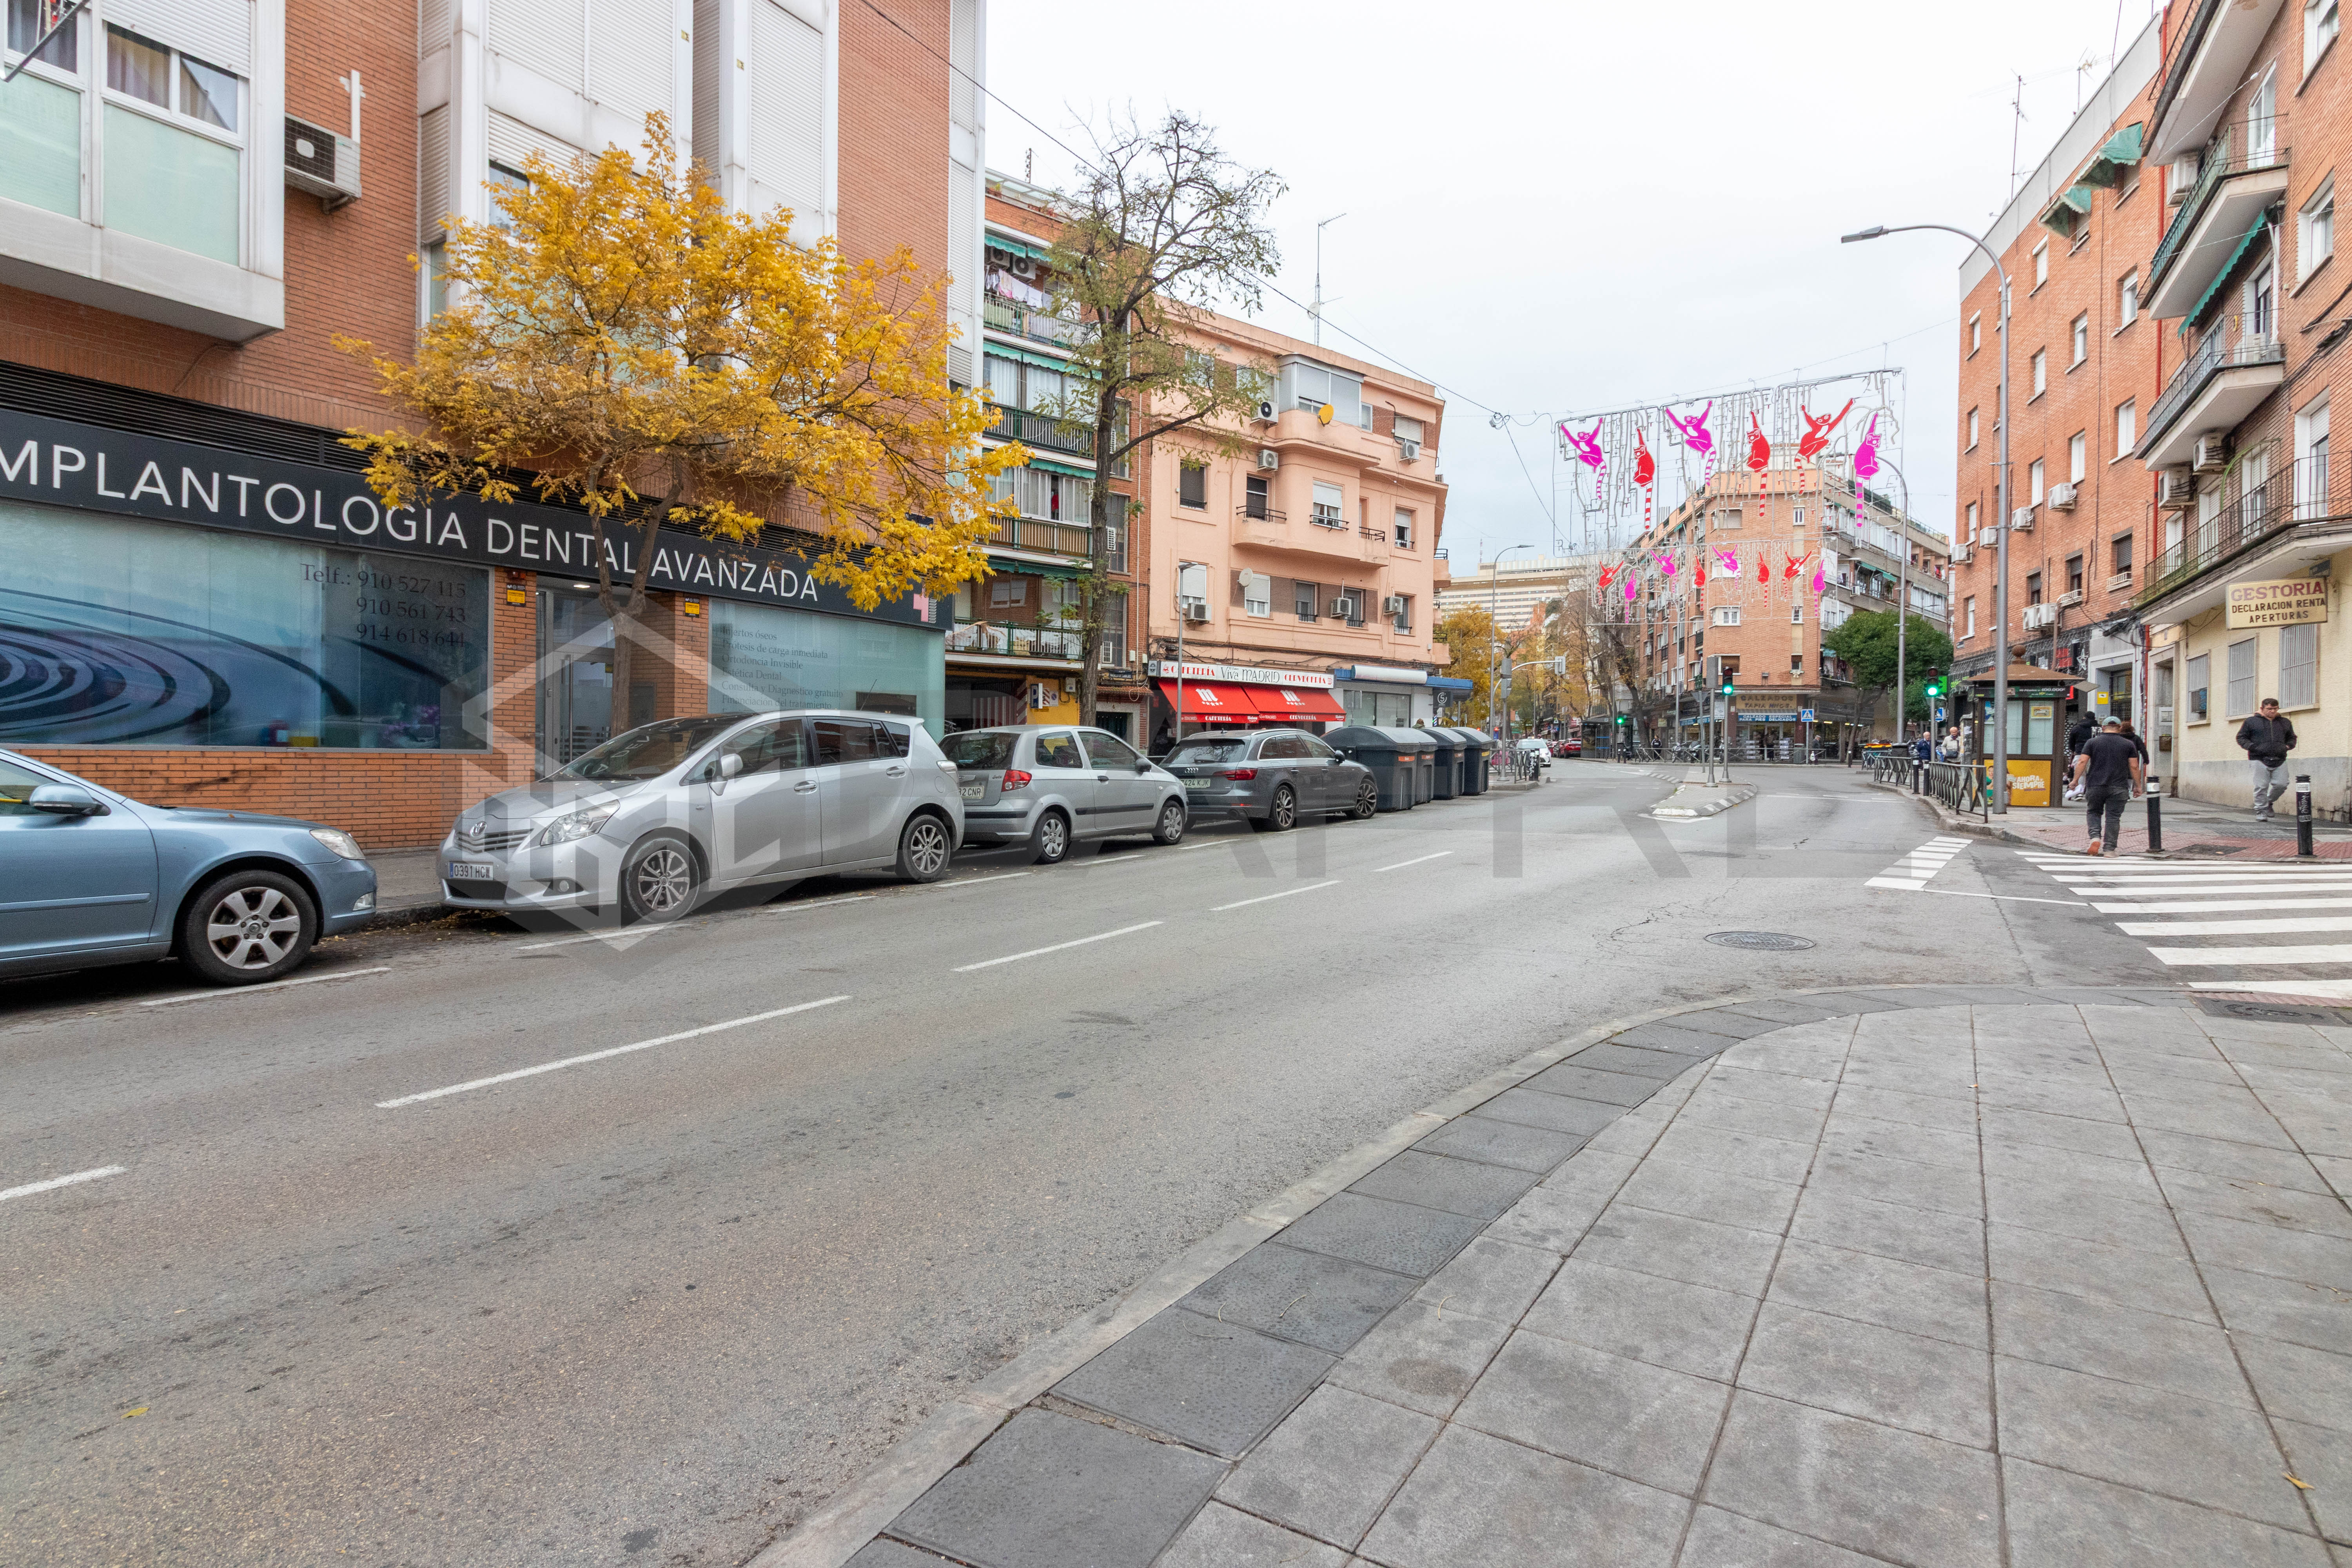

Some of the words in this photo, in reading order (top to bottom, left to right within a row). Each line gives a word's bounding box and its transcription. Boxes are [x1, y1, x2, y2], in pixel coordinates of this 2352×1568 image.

[488, 518, 636, 574] DENTAL
[651, 548, 818, 602] AVANZADA
[299, 563, 351, 585] Telf.:
[357, 571, 392, 590] 910
[398, 576, 430, 593] 527
[438, 581, 466, 598] 115
[2230, 581, 2324, 602] GESTORIA
[356, 597, 391, 616] 910
[396, 601, 426, 619] 561
[436, 605, 466, 623] 743
[2232, 600, 2292, 613] DECLARACION
[2296, 597, 2325, 608] RENTA
[2249, 610, 2309, 624] APERTURAS
[356, 623, 390, 641] 914
[397, 627, 429, 645] 618
[435, 631, 464, 648] 644
[722, 626, 753, 639] Injertos
[755, 630, 777, 641] óseos
[722, 639, 755, 652] Prótesis
[757, 642, 767, 653] de
[768, 646, 789, 657] carga
[791, 648, 828, 659] inmediata
[722, 654, 768, 666] Ortodoncia
[770, 658, 803, 669] Invisible
[722, 667, 753, 679] Estética
[756, 670, 782, 681] Dental
[1171, 666, 1215, 677] CFETERÍA
[1221, 666, 1239, 680] Viva
[1242, 669, 1280, 683] MADRID
[1284, 674, 1326, 684] CERVECERÍA
[722, 681, 759, 692] Consulta
[761, 685, 766, 693] y
[815, 688, 843, 699] gratuito
[722, 695, 772, 707] Financiación
[775, 698, 787, 707] del
[789, 701, 832, 710] tratamiento
[968, 788, 981, 796] CNR
[2012, 781, 2045, 789] SIEMPRE
[455, 865, 472, 877] 0391
